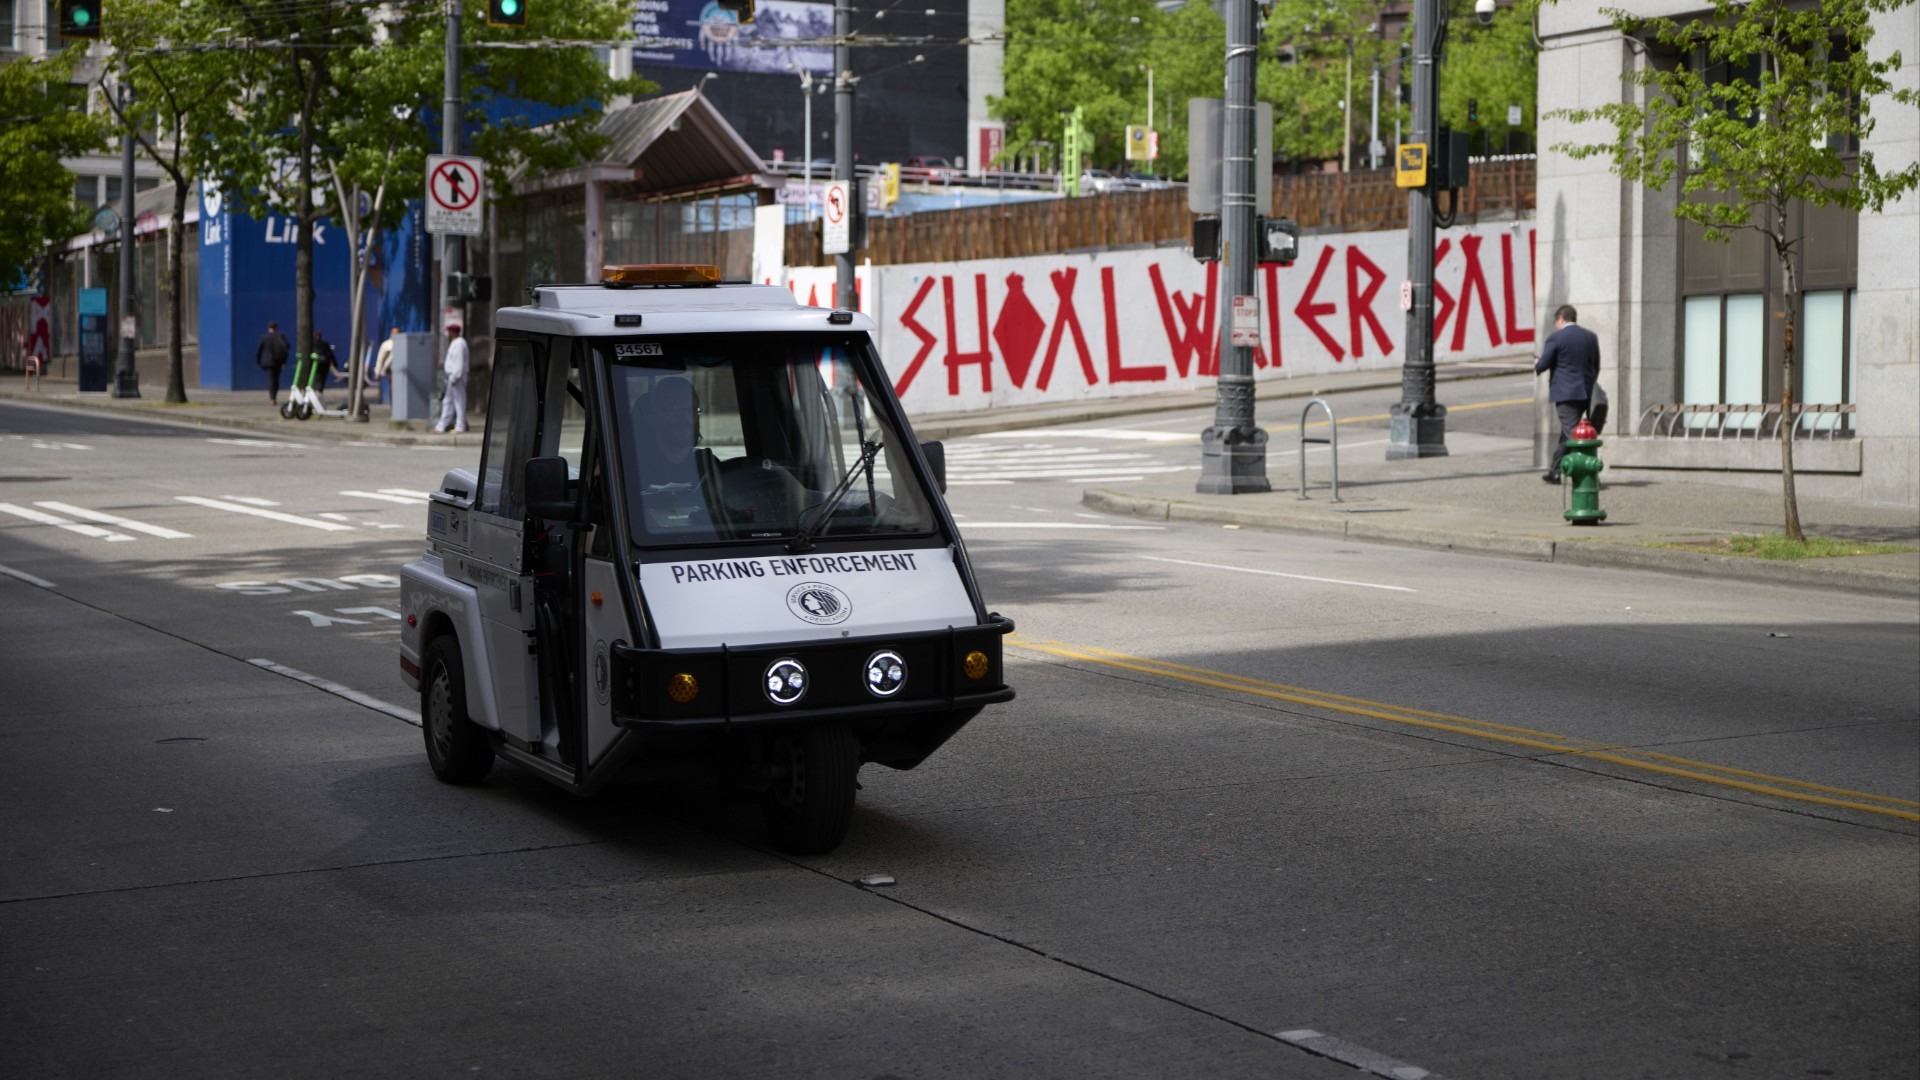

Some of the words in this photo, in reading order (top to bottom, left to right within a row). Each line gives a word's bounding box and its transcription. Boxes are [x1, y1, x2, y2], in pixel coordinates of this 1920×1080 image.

[204, 217, 222, 246] Link
[615, 344, 660, 355] 34567
[671, 560, 765, 584] PARKING
[768, 553, 918, 576] ENFORCEMENT
[812, 584, 836, 593] PRIDE
[809, 609, 849, 623] DEDICATION
